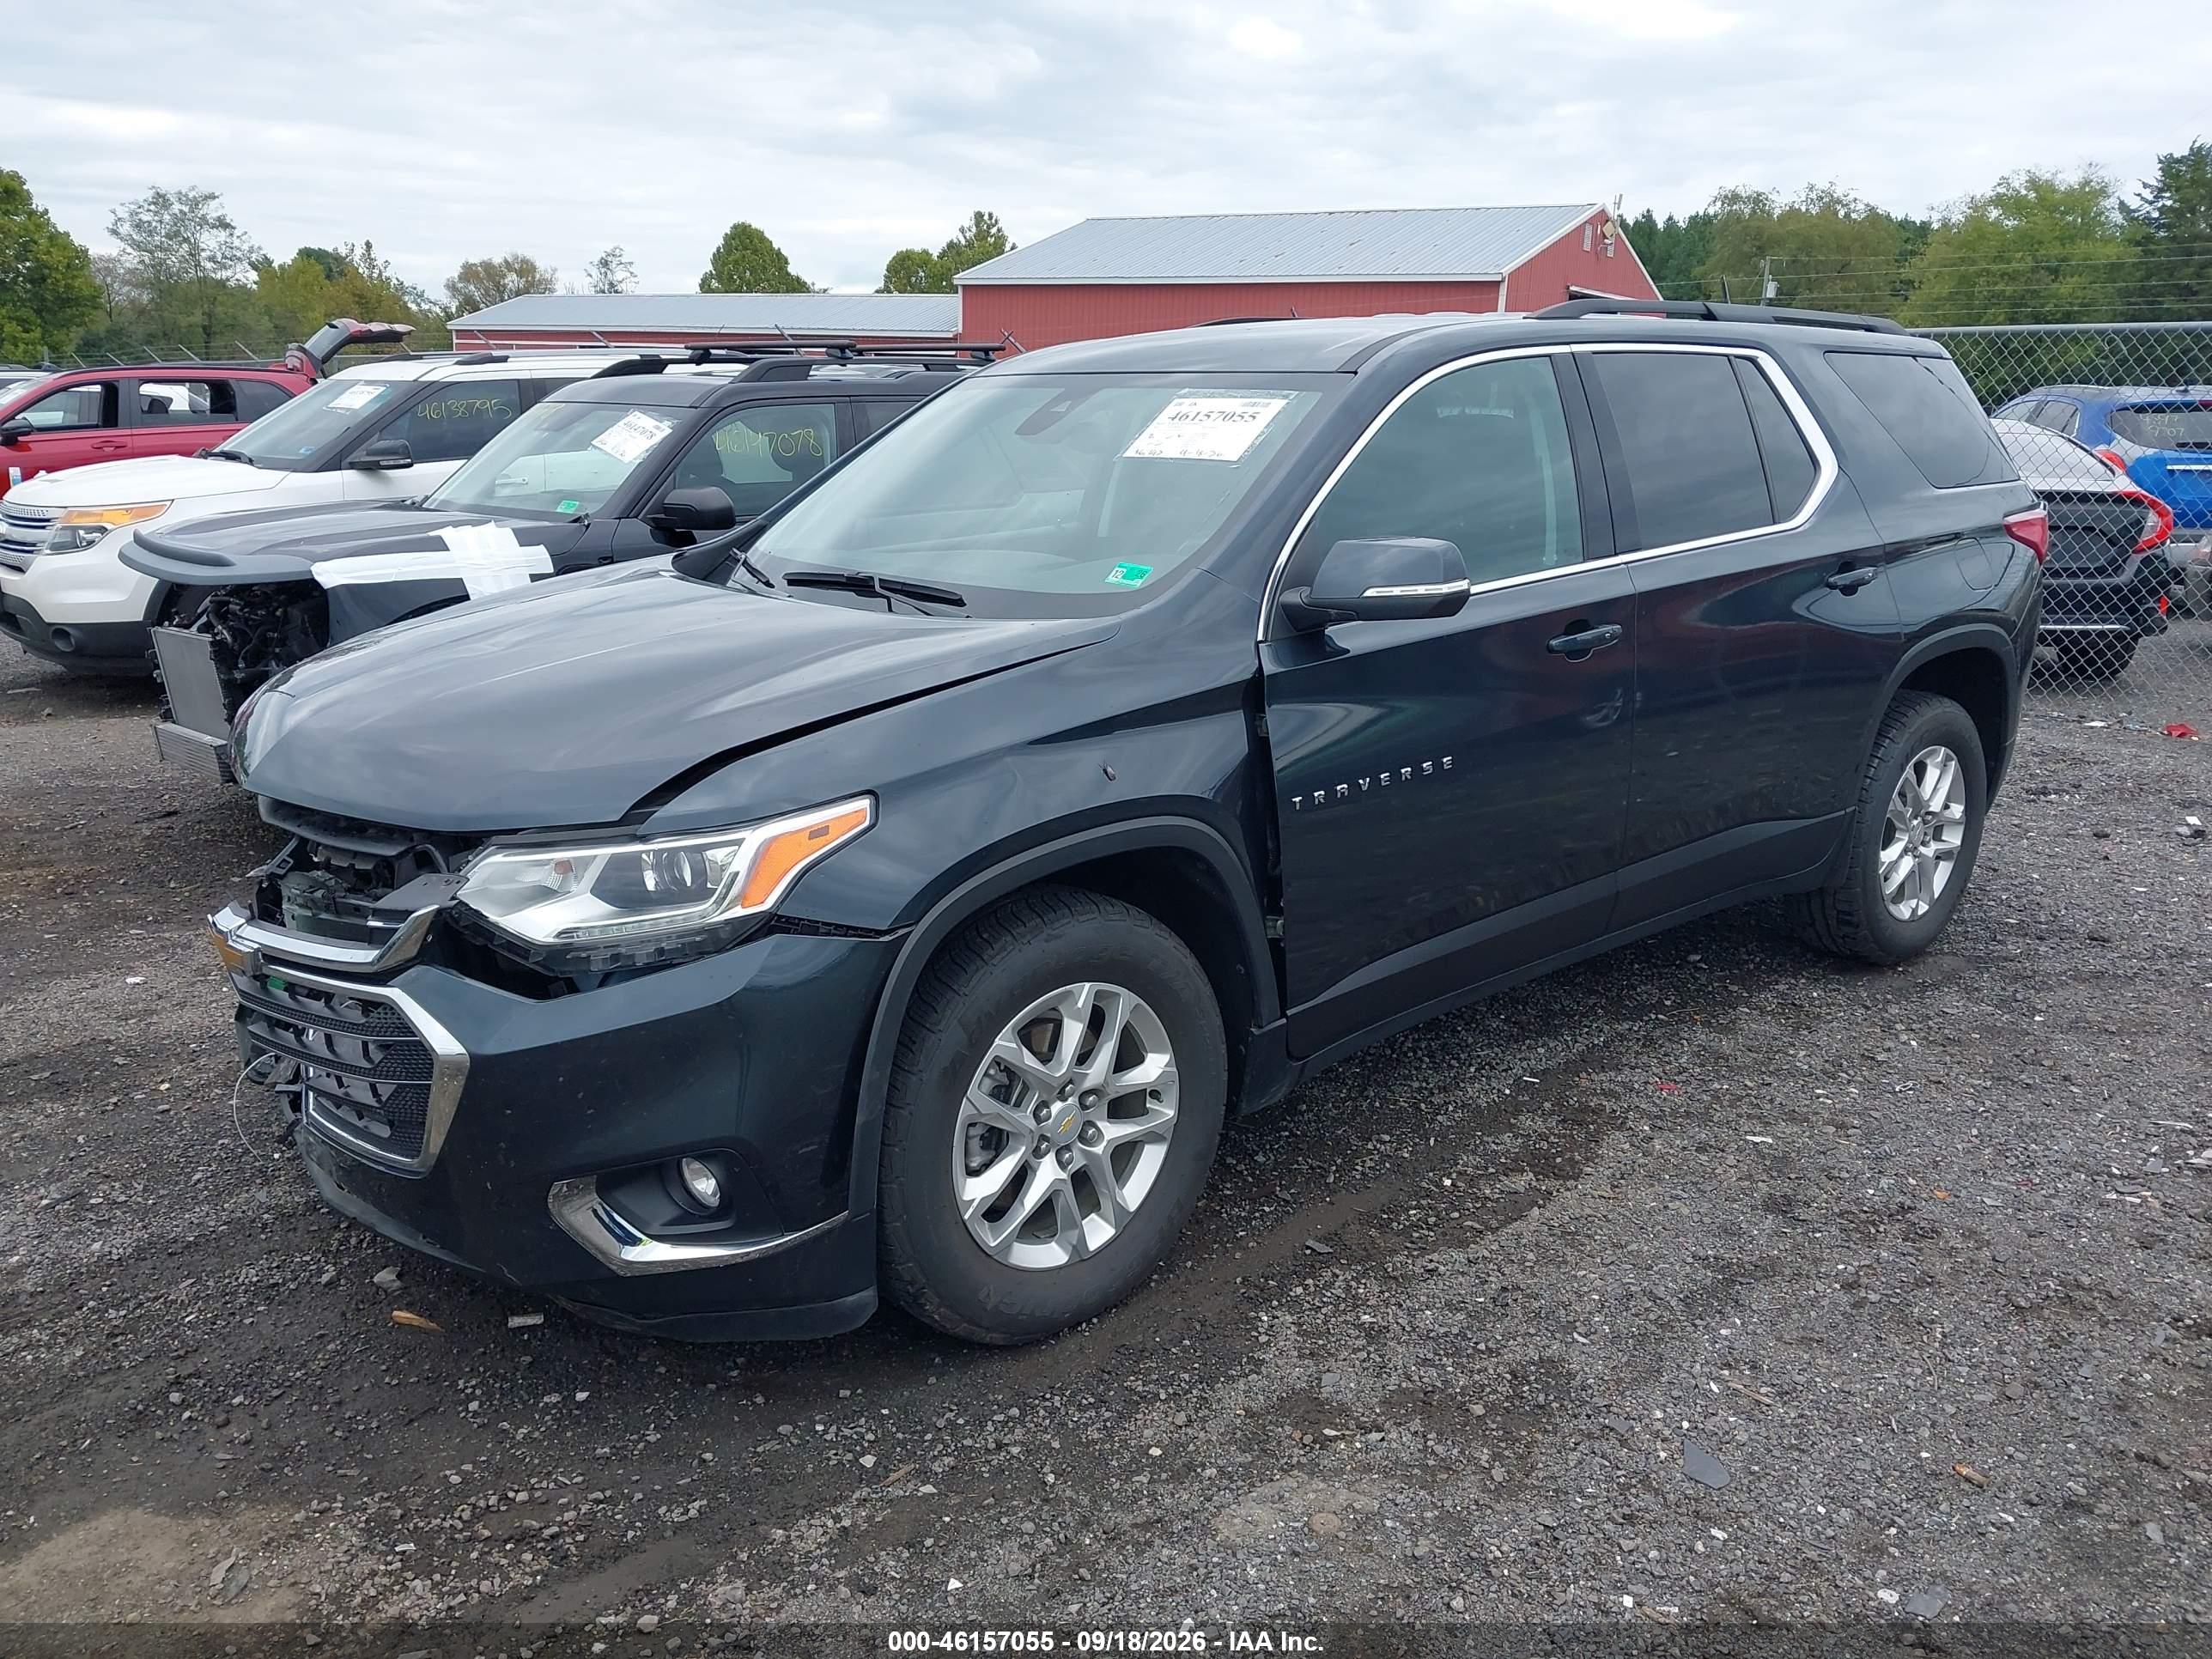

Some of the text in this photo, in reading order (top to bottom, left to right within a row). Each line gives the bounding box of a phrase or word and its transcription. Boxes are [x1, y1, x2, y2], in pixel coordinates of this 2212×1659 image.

[417, 398, 512, 420] 46138795
[1168, 410, 1261, 422] 46157055
[715, 428, 823, 457] 46147078
[1111, 569, 1148, 580] 12 26
[1291, 756, 1453, 811] TRAVERSE
